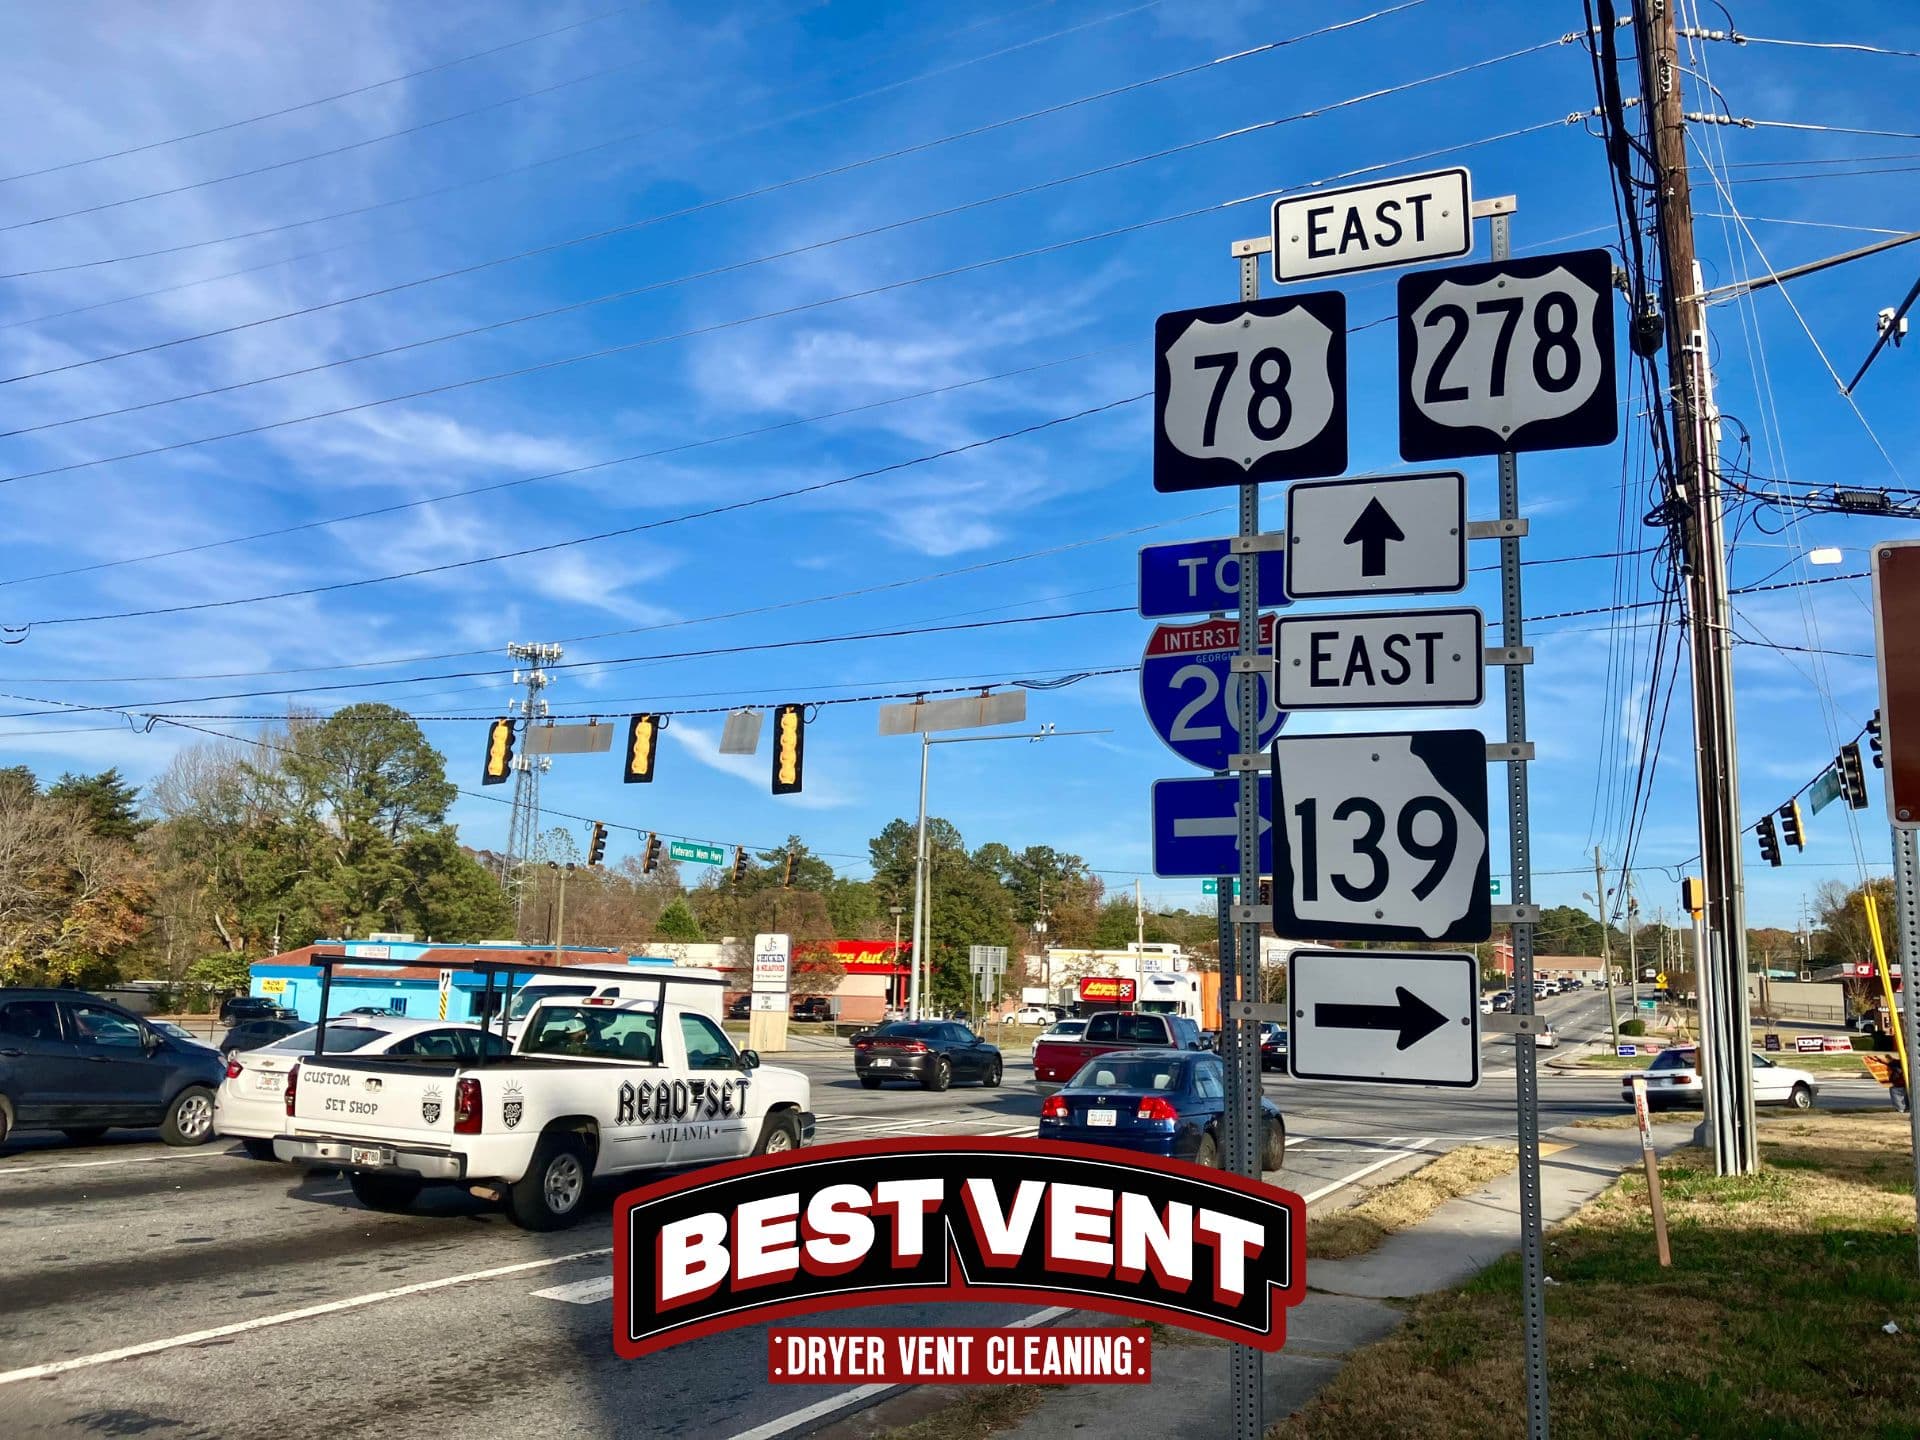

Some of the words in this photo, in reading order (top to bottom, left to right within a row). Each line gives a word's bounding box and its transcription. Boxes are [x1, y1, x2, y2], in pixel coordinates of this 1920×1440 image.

[1307, 193, 1433, 258] EAST
[1423, 291, 1582, 404] 278
[1194, 346, 1293, 447] 78
[1178, 555, 1241, 597] TO
[1164, 624, 1269, 651] INTERSTE
[1310, 632, 1443, 687] EAST
[1168, 664, 1279, 742] 20
[671, 844, 694, 858] Veterans
[696, 847, 709, 860] Mem
[710, 850, 722, 864] Hwy
[1294, 796, 1458, 902] 139
[303, 1071, 351, 1086] CUSTOM
[703, 1077, 752, 1119] SET
[325, 1098, 346, 1112] SET
[349, 1100, 379, 1115] SHOP
[657, 1125, 711, 1144] ATLANTA
